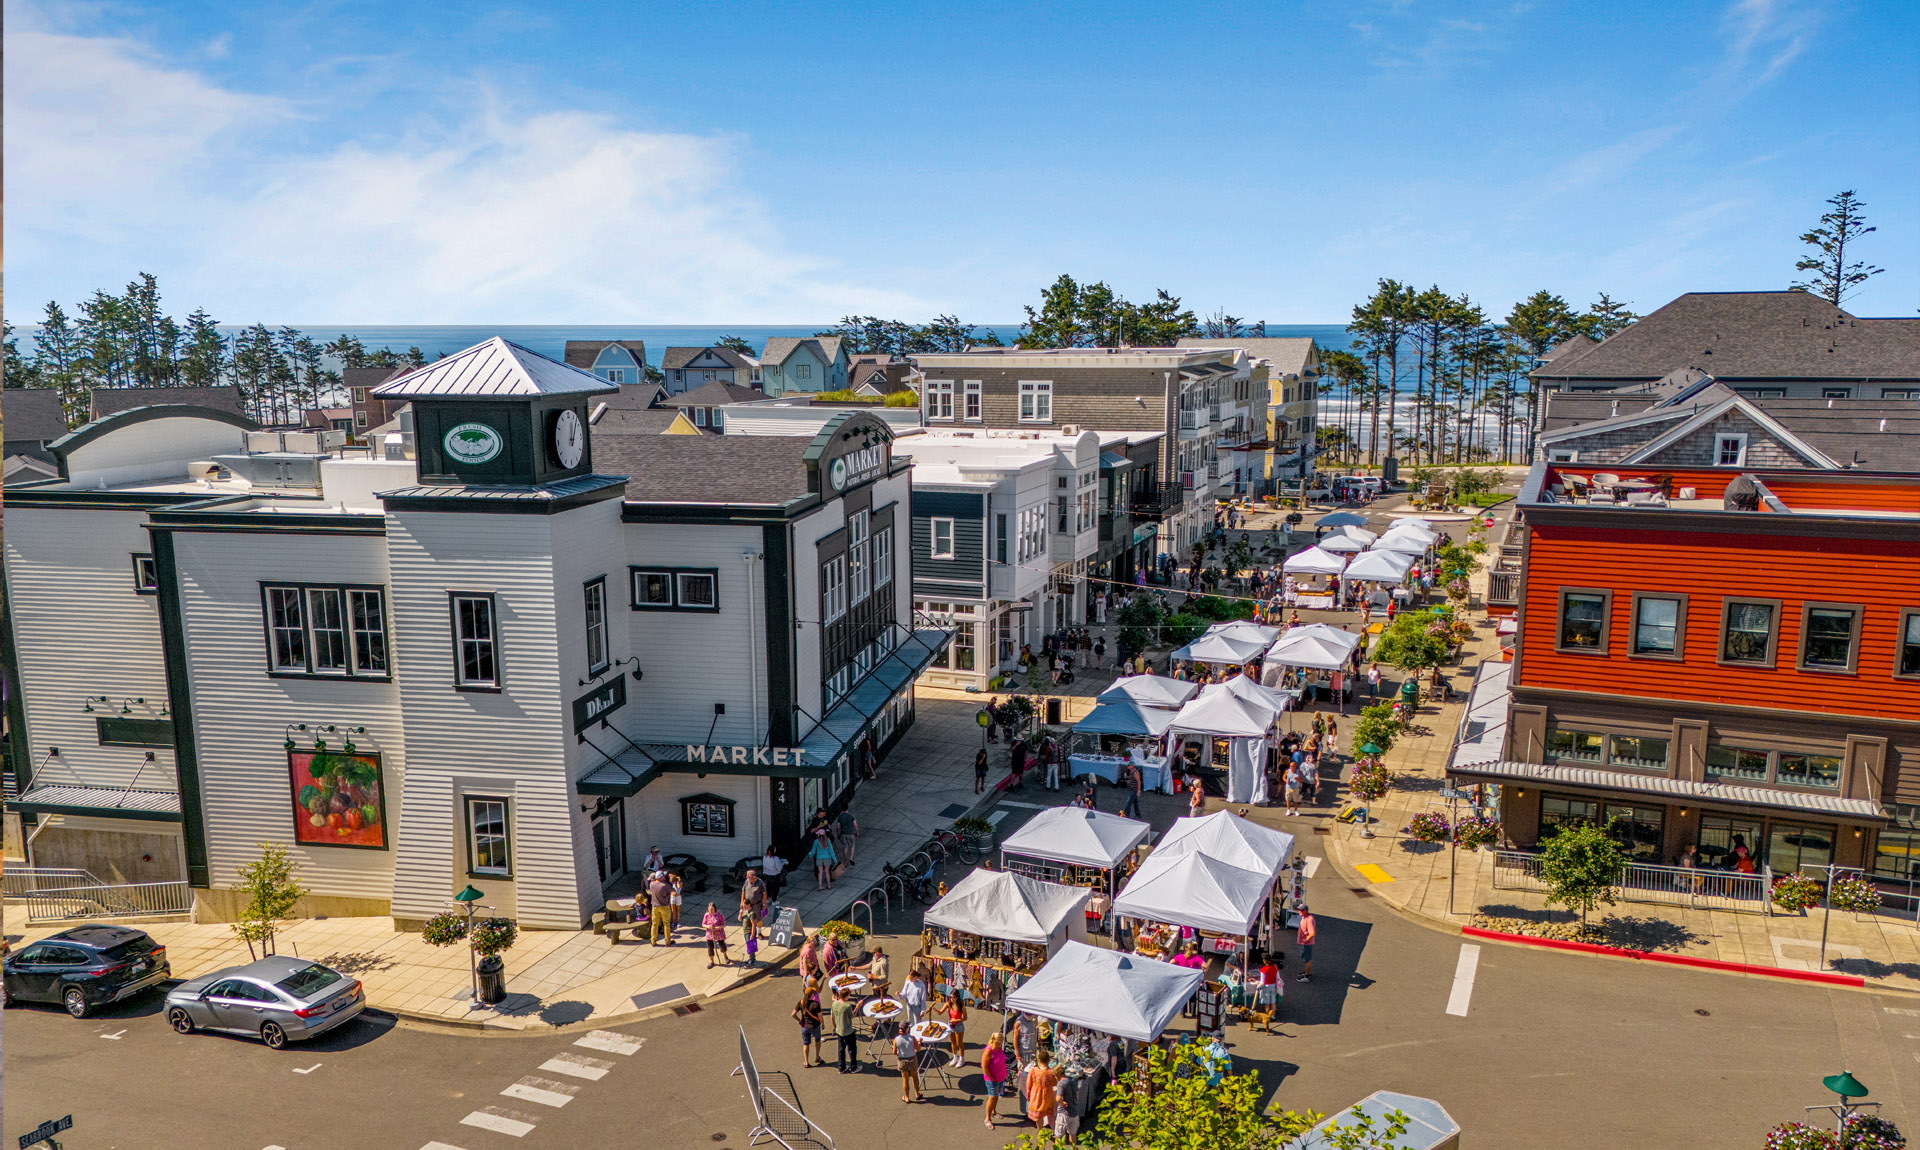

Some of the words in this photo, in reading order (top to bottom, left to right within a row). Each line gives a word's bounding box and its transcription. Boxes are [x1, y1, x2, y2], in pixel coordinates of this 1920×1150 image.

[845, 444, 883, 476] MARKET
[687, 744, 806, 767] MARKET
[836, 751, 848, 767] WINE
[772, 924, 791, 933] HOUSE
[776, 918, 791, 926] OPEN
[21, 1123, 56, 1146] SEABROOK
